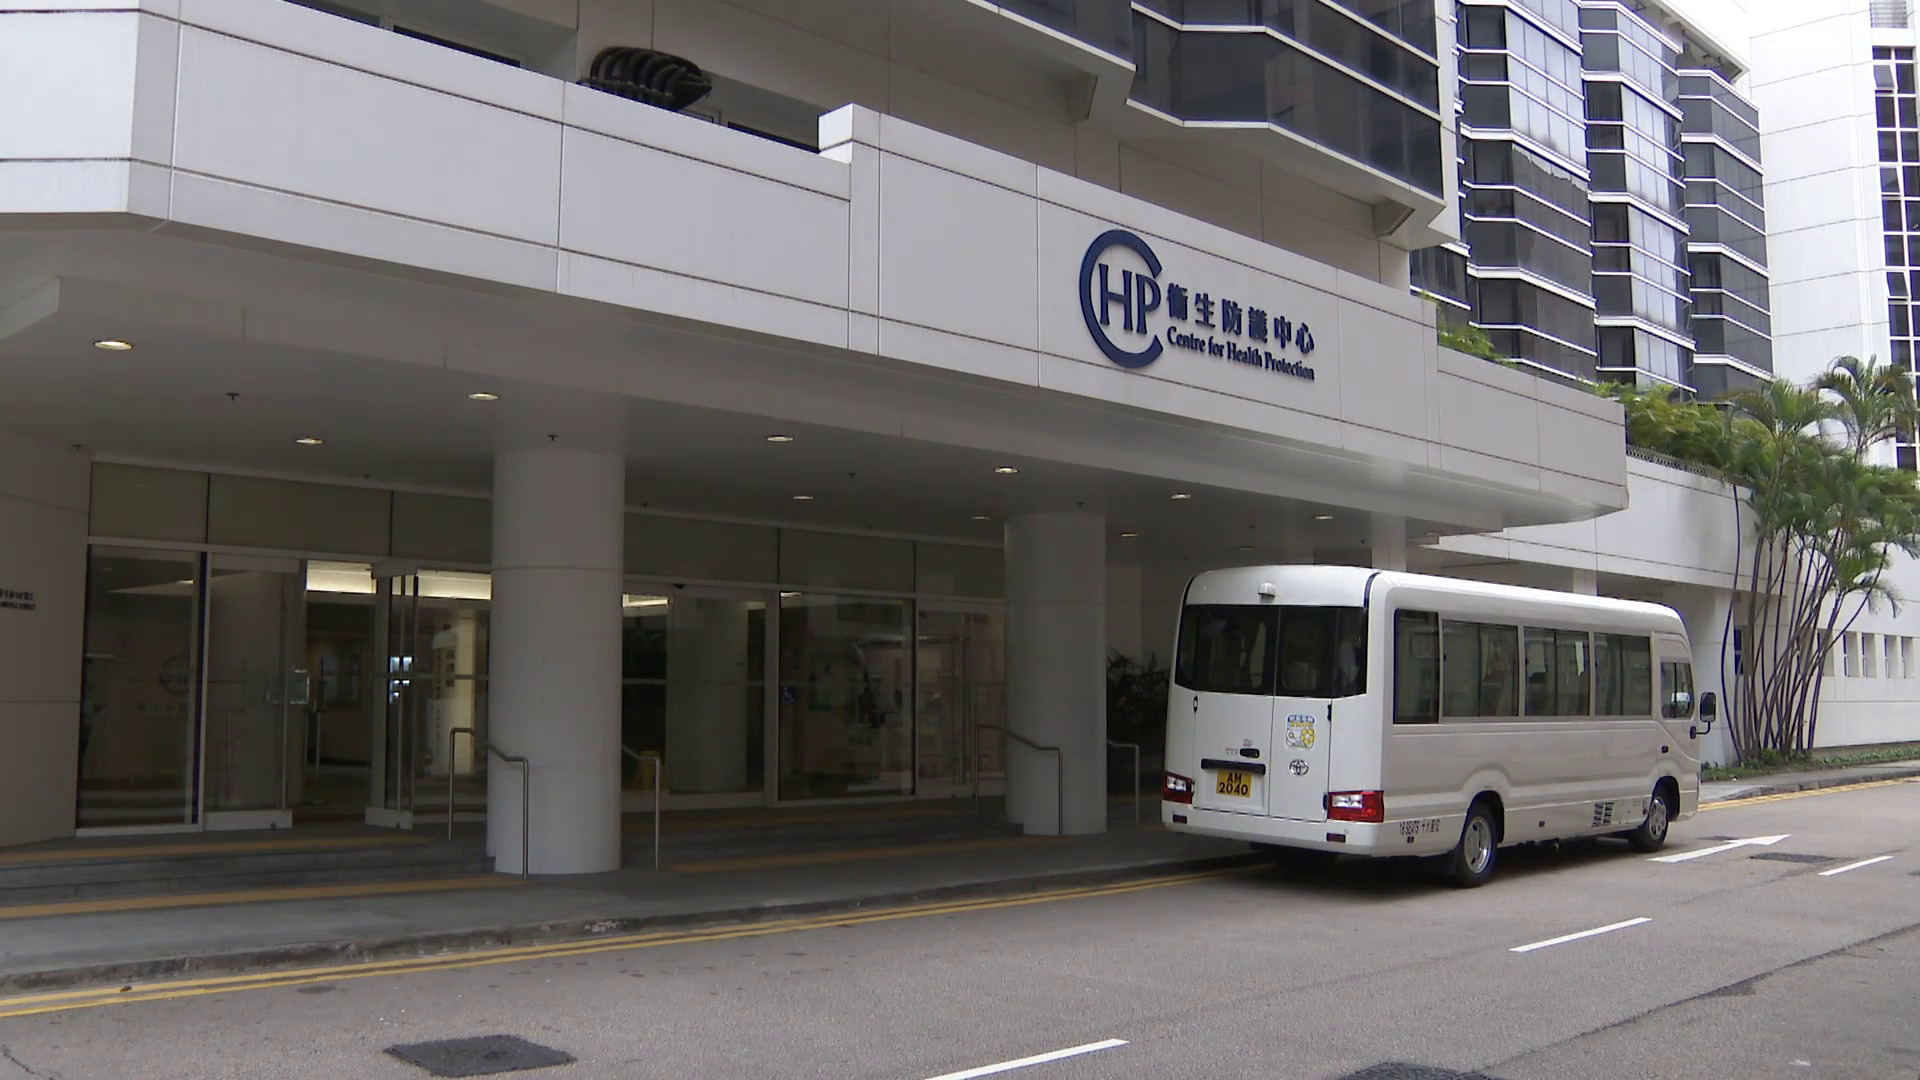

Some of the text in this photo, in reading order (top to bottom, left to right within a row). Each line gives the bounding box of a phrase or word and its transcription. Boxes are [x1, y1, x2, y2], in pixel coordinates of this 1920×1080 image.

[1167, 326, 1315, 381] Centre for Health Protection
[1226, 772, 1242, 784] AM
[1218, 782, 1249, 796] 2040
